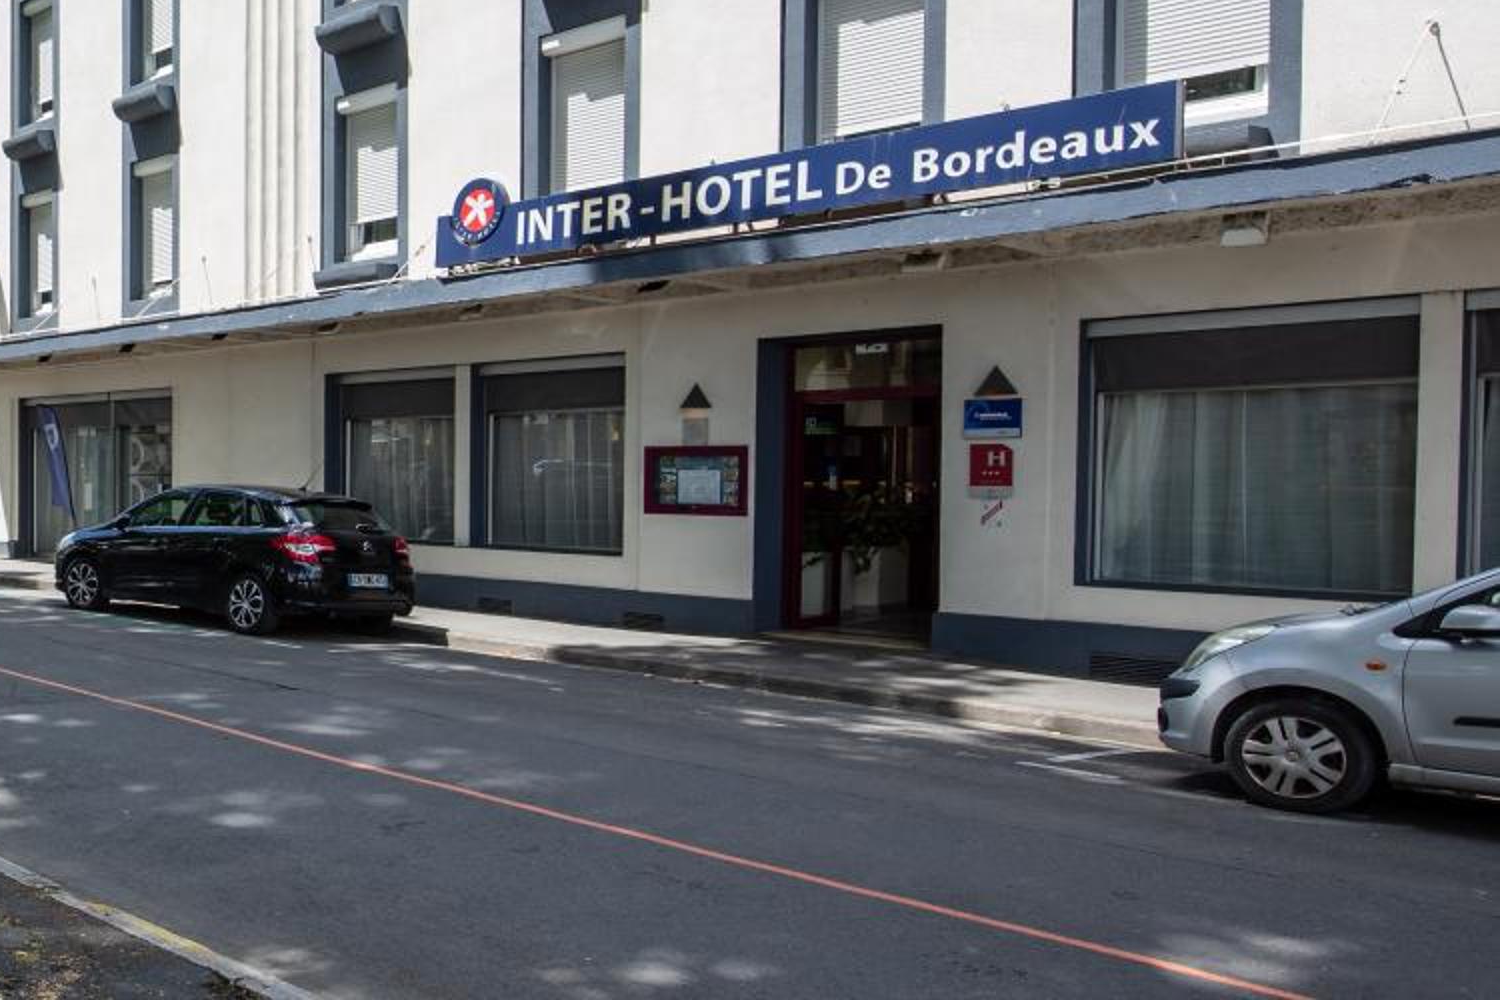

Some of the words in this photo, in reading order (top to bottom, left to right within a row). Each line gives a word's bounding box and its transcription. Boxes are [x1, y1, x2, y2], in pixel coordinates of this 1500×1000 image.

[835, 160, 892, 196] De
[912, 118, 1161, 184] Bordeaux
[987, 450, 1006, 467] H
